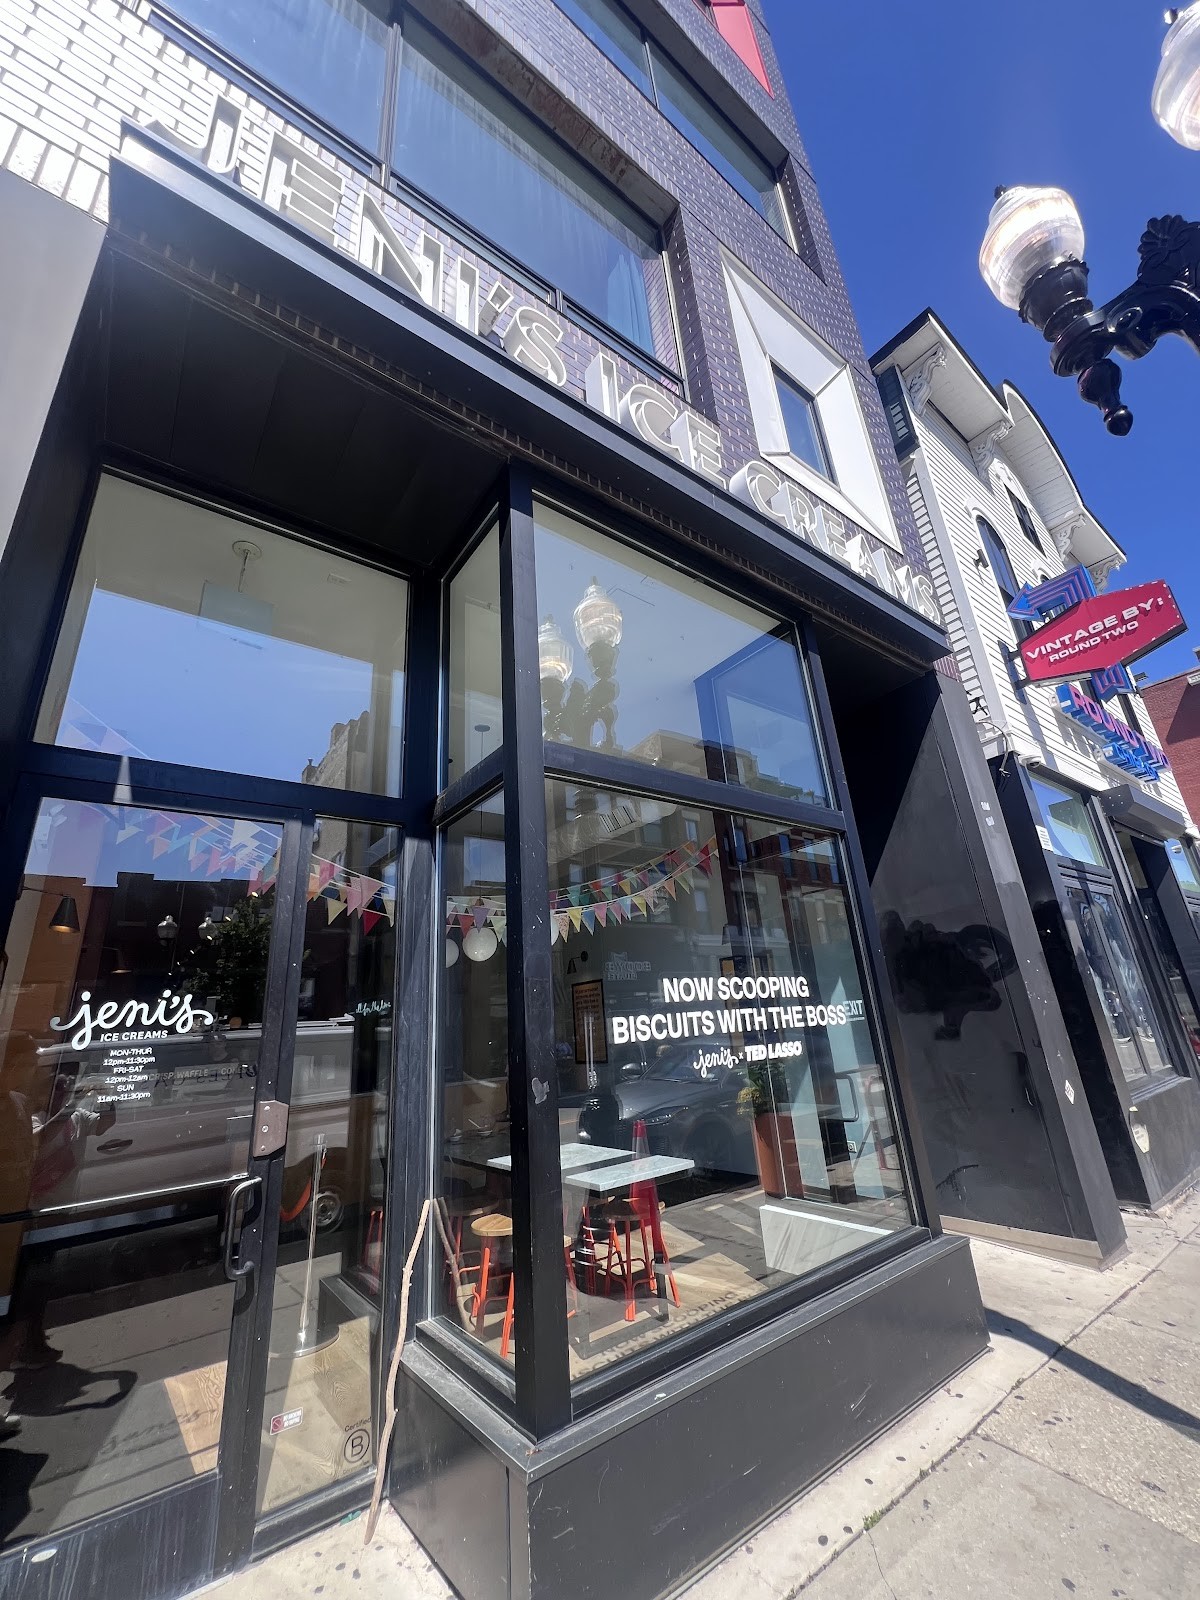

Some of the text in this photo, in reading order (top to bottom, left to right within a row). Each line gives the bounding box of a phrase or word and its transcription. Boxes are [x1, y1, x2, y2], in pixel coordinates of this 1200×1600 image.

[142, 92, 942, 626] JENI'S ICE CREAMS
[1026, 598, 1164, 660] VINTAGE BY:
[1050, 620, 1139, 663] ROUND TWO
[1066, 683, 1139, 749] ROUND
[662, 975, 810, 1003] NOW SCOOPING
[843, 1000, 863, 1016] EXIT
[50, 989, 214, 1051] jeni's
[612, 1004, 847, 1044] BISCUITS WITH THE BOSS
[100, 1029, 169, 1043] ICE CREAMS
[102, 1056, 156, 1067] 12pm-11:30pm
[110, 1047, 153, 1057] MON-THUR
[693, 1046, 739, 1078] jeni's
[744, 1044, 767, 1062] TED
[767, 1040, 803, 1059] LASSO
[104, 1074, 149, 1084] 12pm-12am
[113, 1065, 145, 1075] FRI-SAT
[176, 1068, 209, 1079] WAFFLE
[97, 1092, 151, 1103] 11am-11:30pm
[116, 1084, 135, 1092] SUN
[351, 1435, 364, 1457] B
